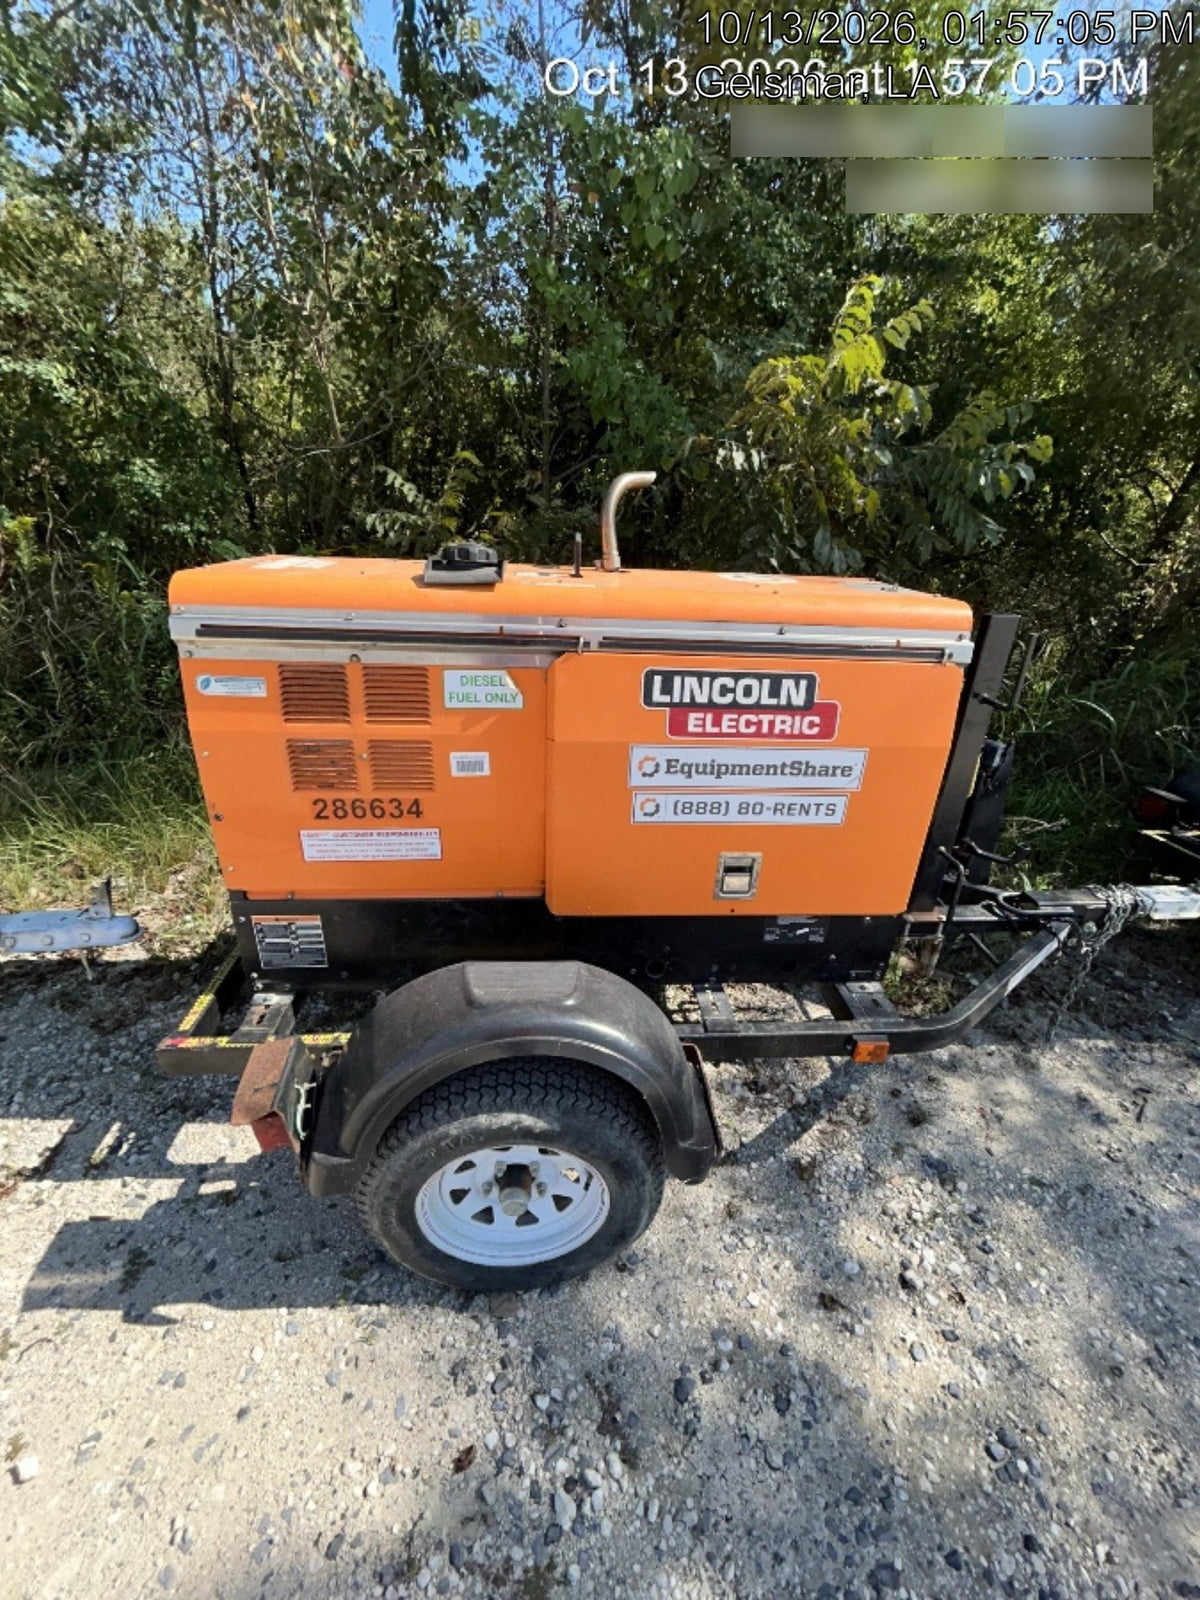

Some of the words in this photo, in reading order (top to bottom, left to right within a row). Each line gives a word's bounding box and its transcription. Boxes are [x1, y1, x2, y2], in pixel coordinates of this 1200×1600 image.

[459, 674, 507, 688] DIESEL
[652, 674, 808, 707] LINCOLN
[448, 691, 481, 704] FUEL
[484, 691, 519, 704] ONLY
[687, 711, 821, 736] ELECTRIC
[664, 757, 854, 780] EquipmentShare
[311, 797, 423, 820] 286634
[672, 800, 730, 817] (888)
[737, 800, 837, 817] 80-RENTS
